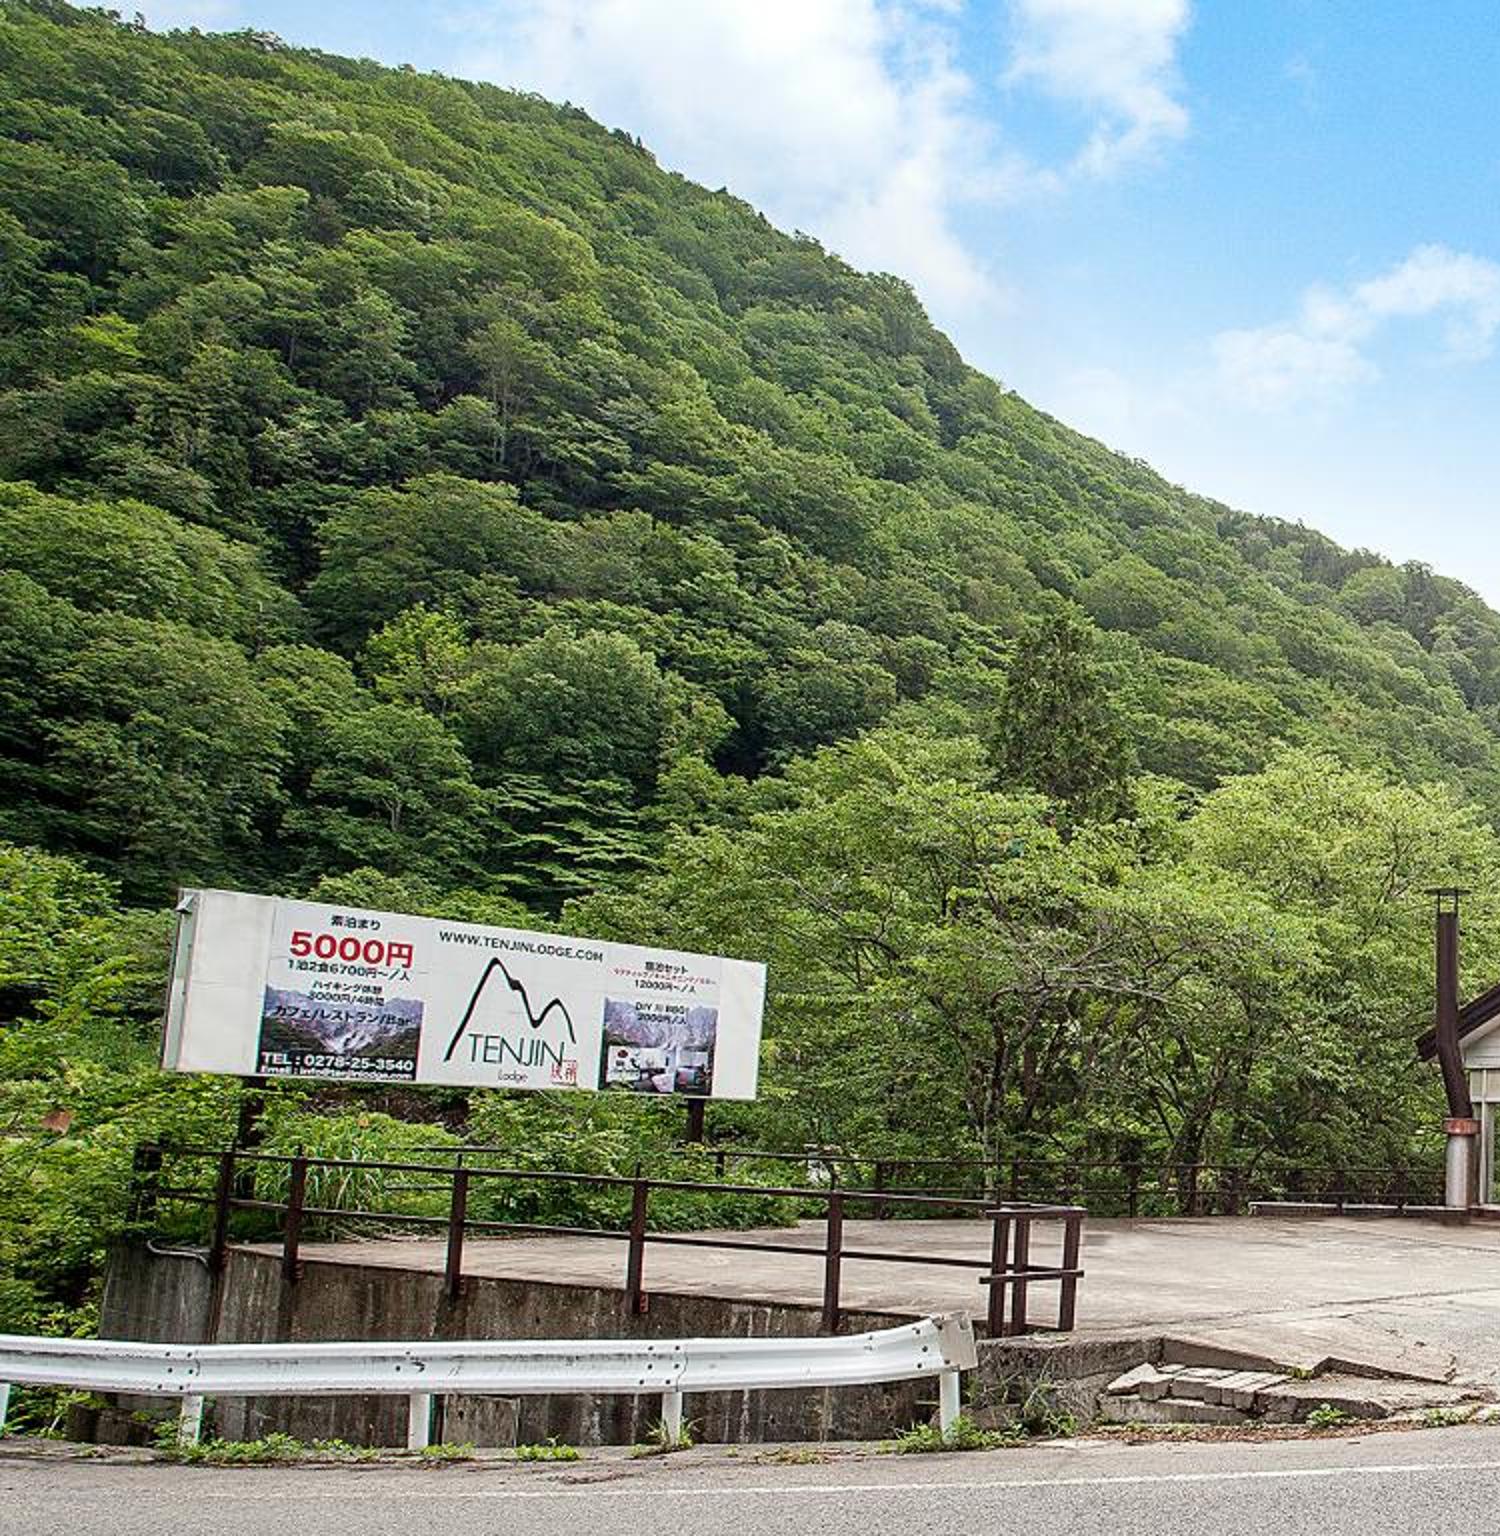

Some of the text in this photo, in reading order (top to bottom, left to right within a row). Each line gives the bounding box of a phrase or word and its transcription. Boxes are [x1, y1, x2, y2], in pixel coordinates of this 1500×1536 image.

[289, 931, 414, 969] 5000円
[439, 931, 603, 962] WWW.TENJINLODGE.COM
[303, 1053, 414, 1072] 0278-25-3540
[468, 1033, 565, 1067] TENJIN
[497, 1069, 528, 1083] Lodge
